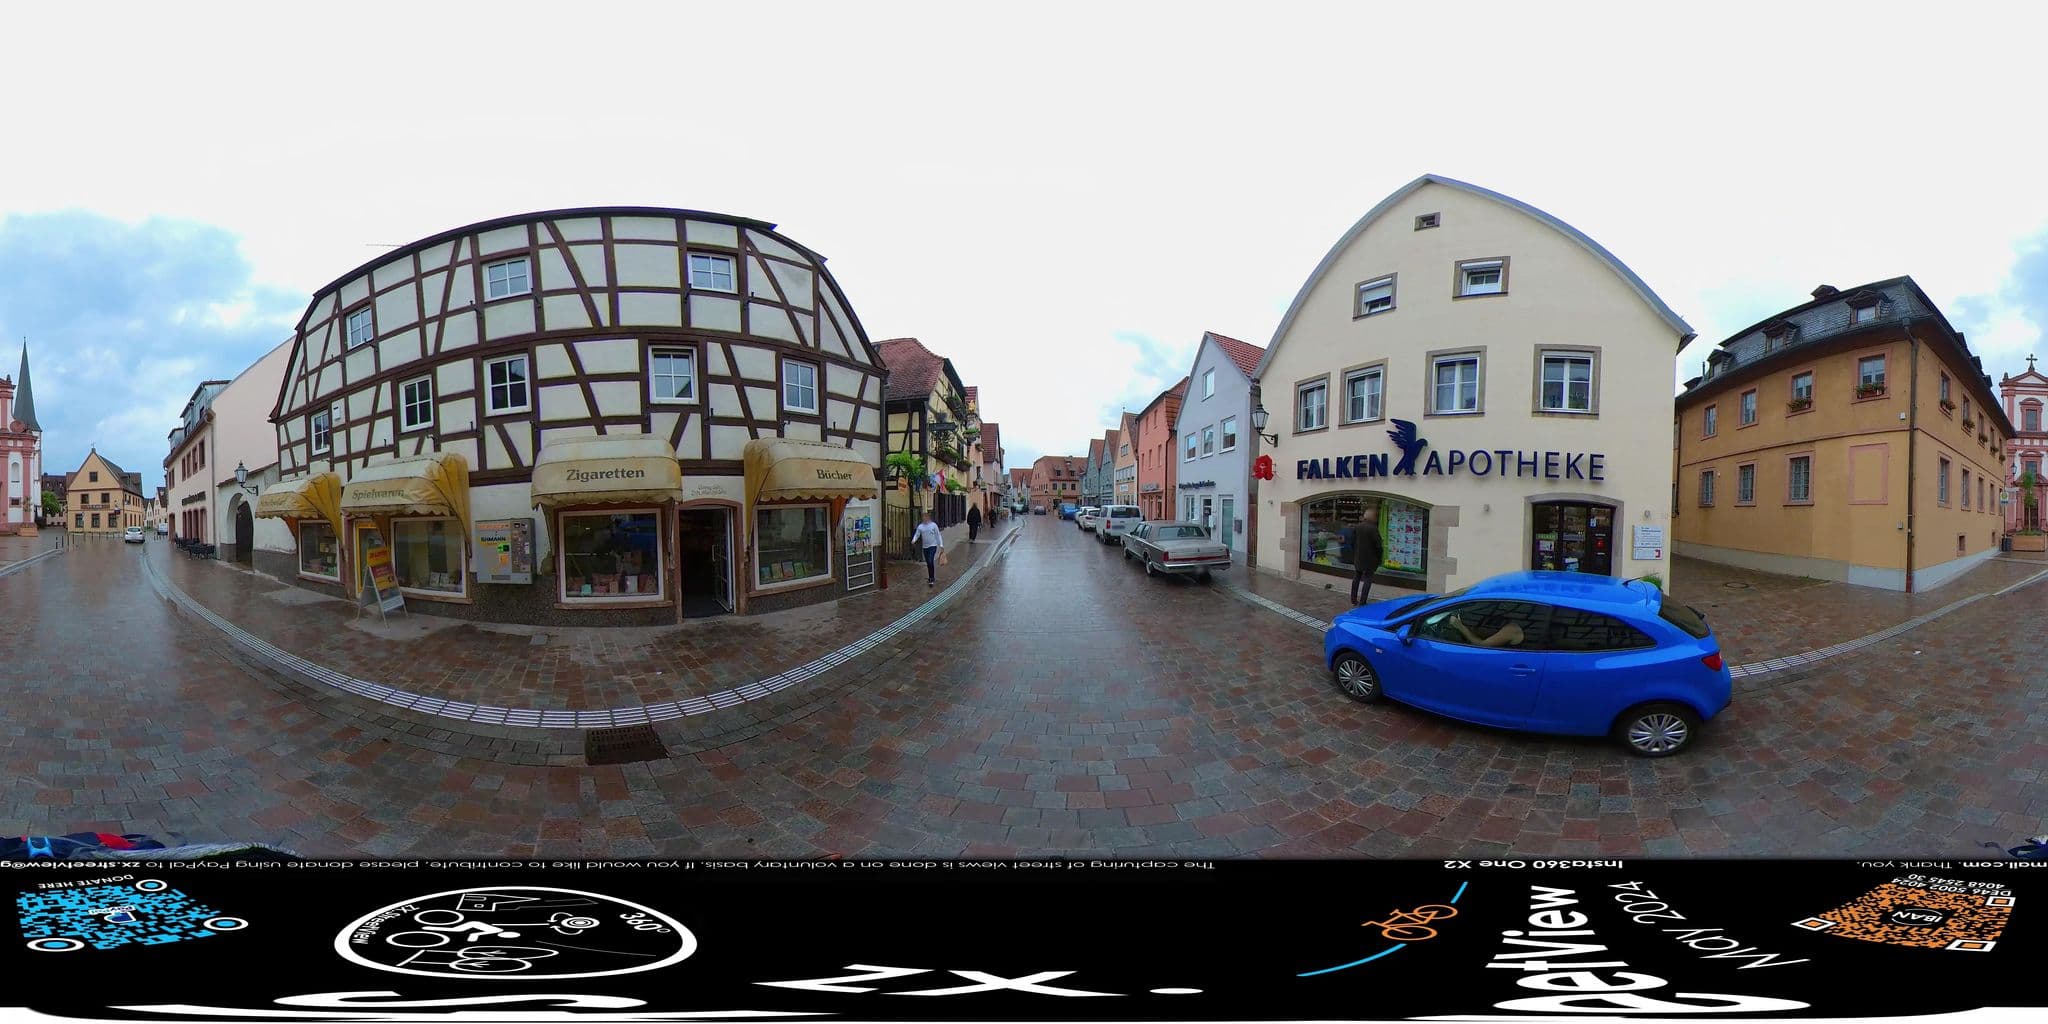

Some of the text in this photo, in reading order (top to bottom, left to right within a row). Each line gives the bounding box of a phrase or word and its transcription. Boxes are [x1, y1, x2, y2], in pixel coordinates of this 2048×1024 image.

[1296, 450, 1605, 481] FALKEN APOTHEKE
[566, 468, 645, 483] Zigaretten
[816, 469, 853, 481] Bücher
[352, 489, 405, 501] Spielwaren
